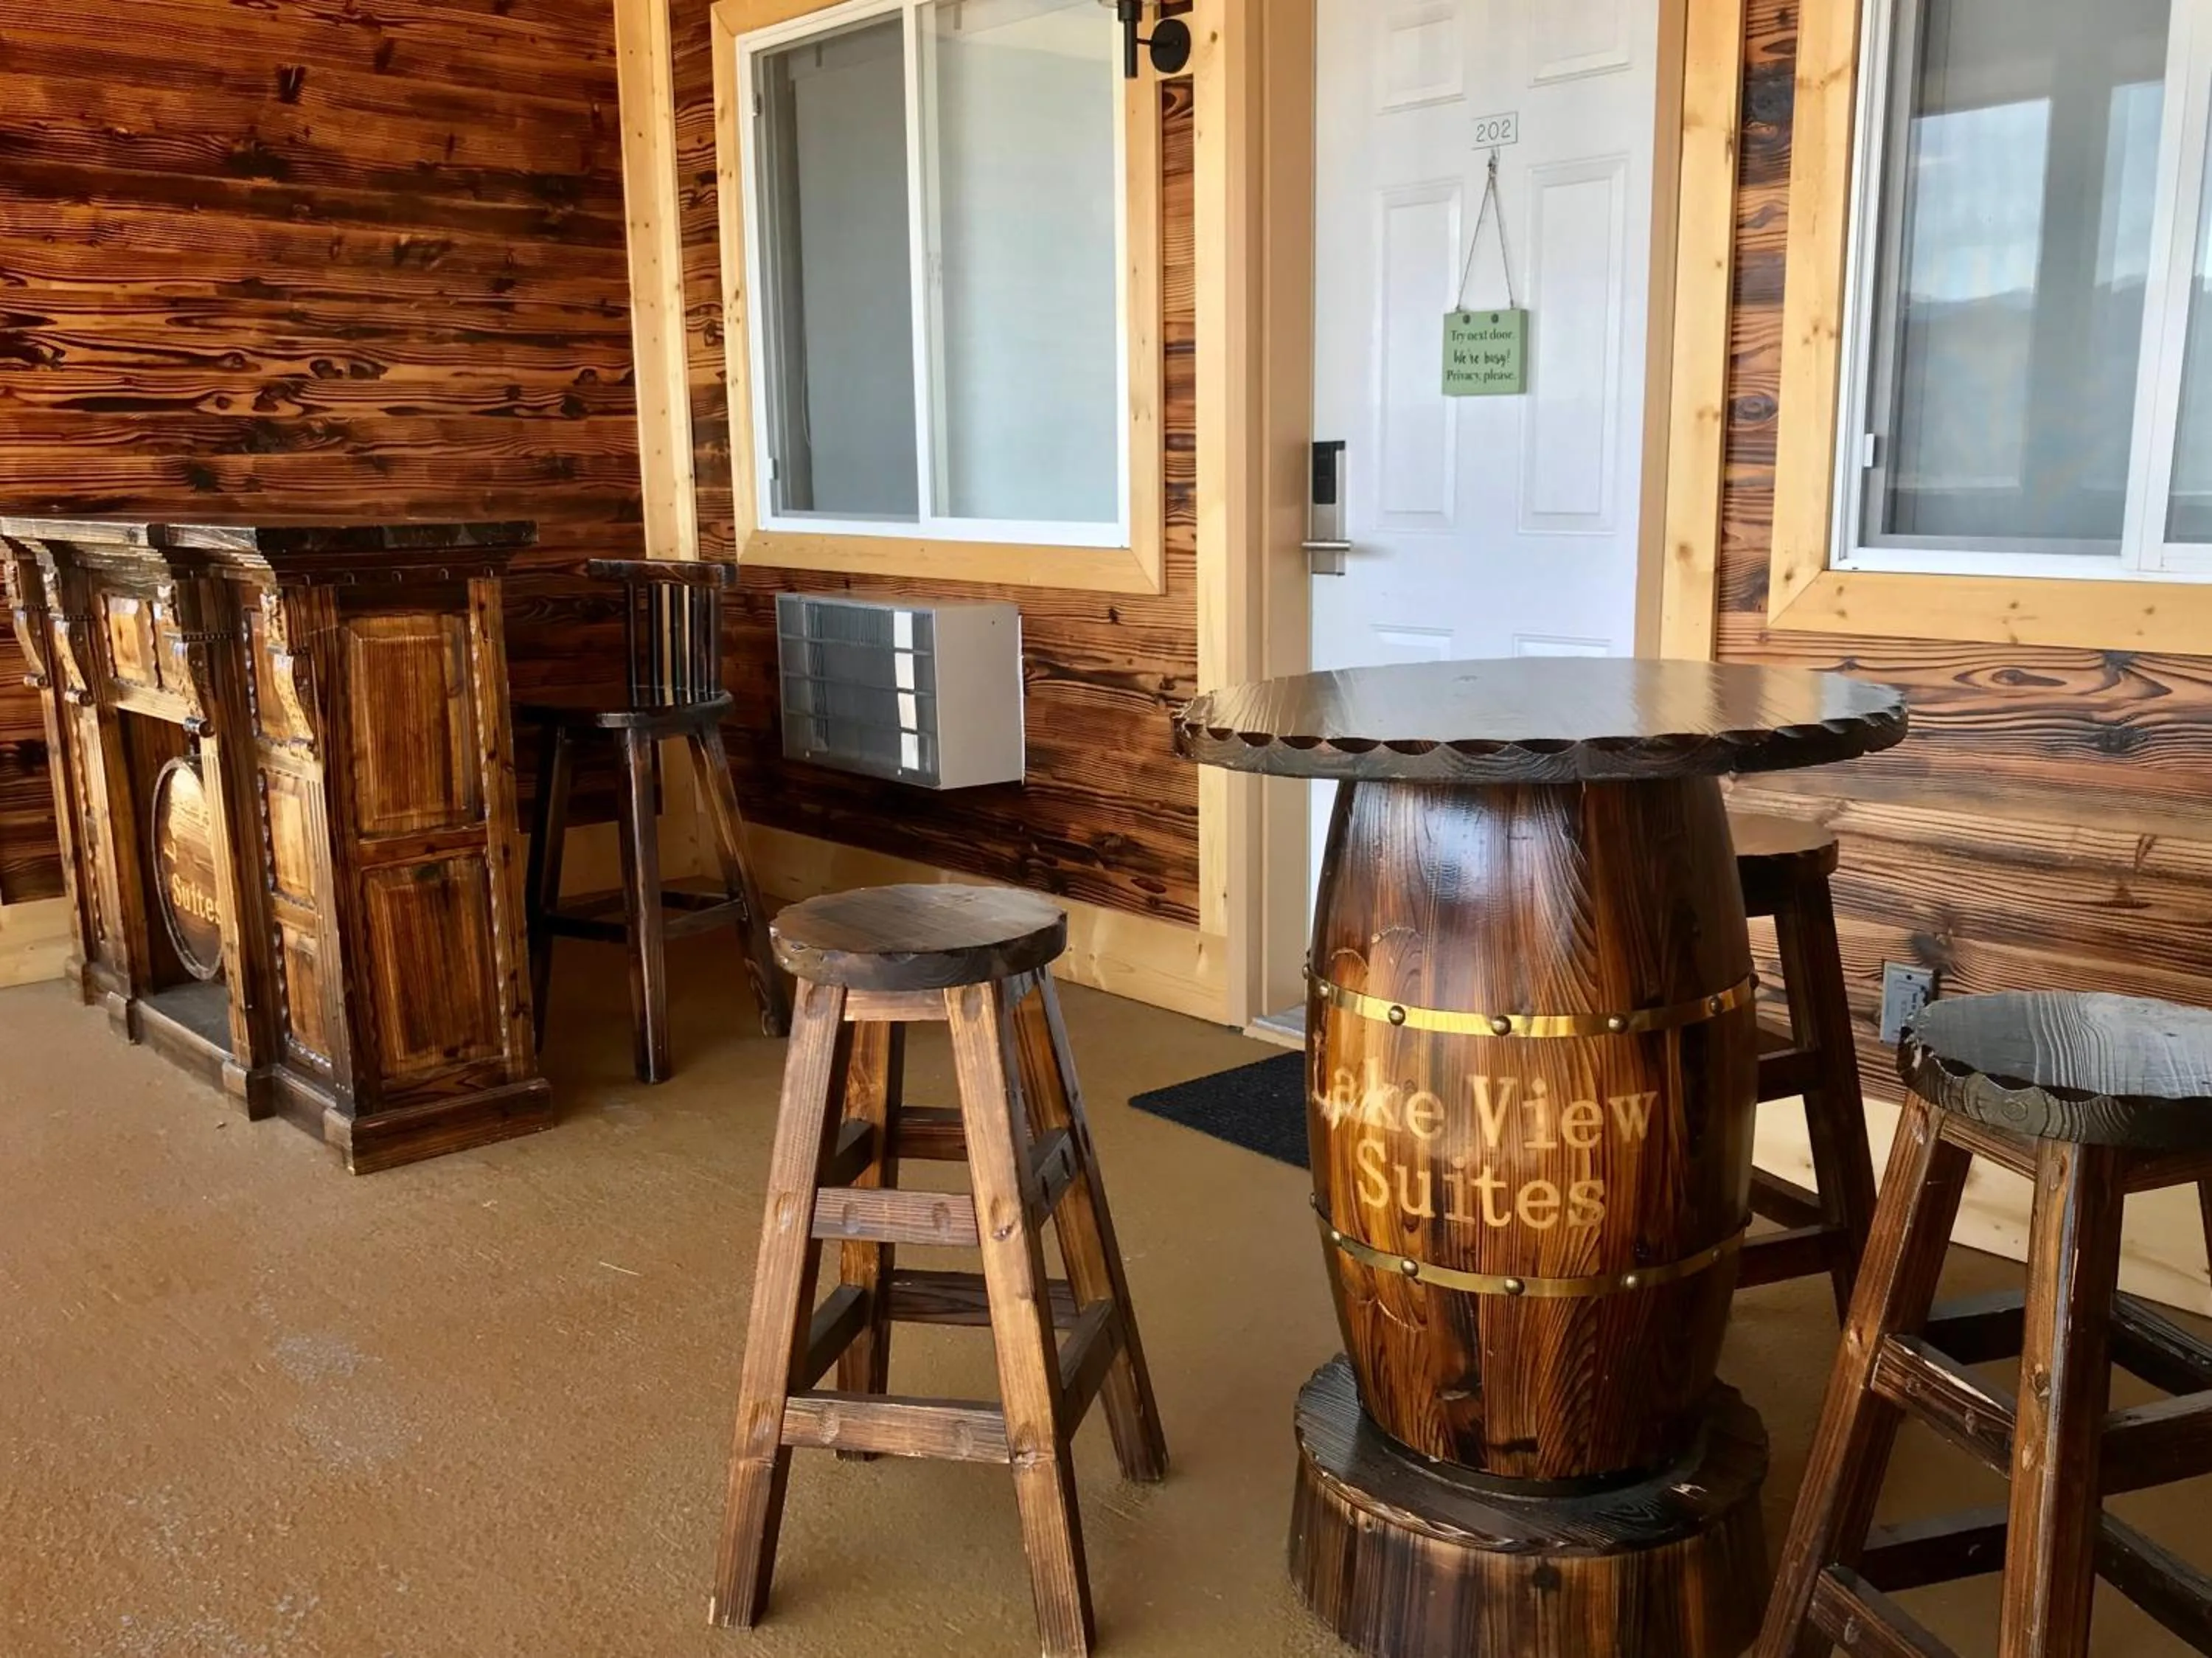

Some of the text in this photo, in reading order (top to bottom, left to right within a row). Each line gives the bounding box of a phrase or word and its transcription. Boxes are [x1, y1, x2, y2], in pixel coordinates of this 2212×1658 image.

[1475, 119, 1512, 142] 202
[1451, 330, 1465, 344] Try
[1467, 330, 1488, 341] next
[1453, 348, 1511, 367] We're busy!
[172, 873, 221, 924] Suites
[1466, 1075, 1658, 1149] View
[1356, 1138, 1605, 1229] Suites
